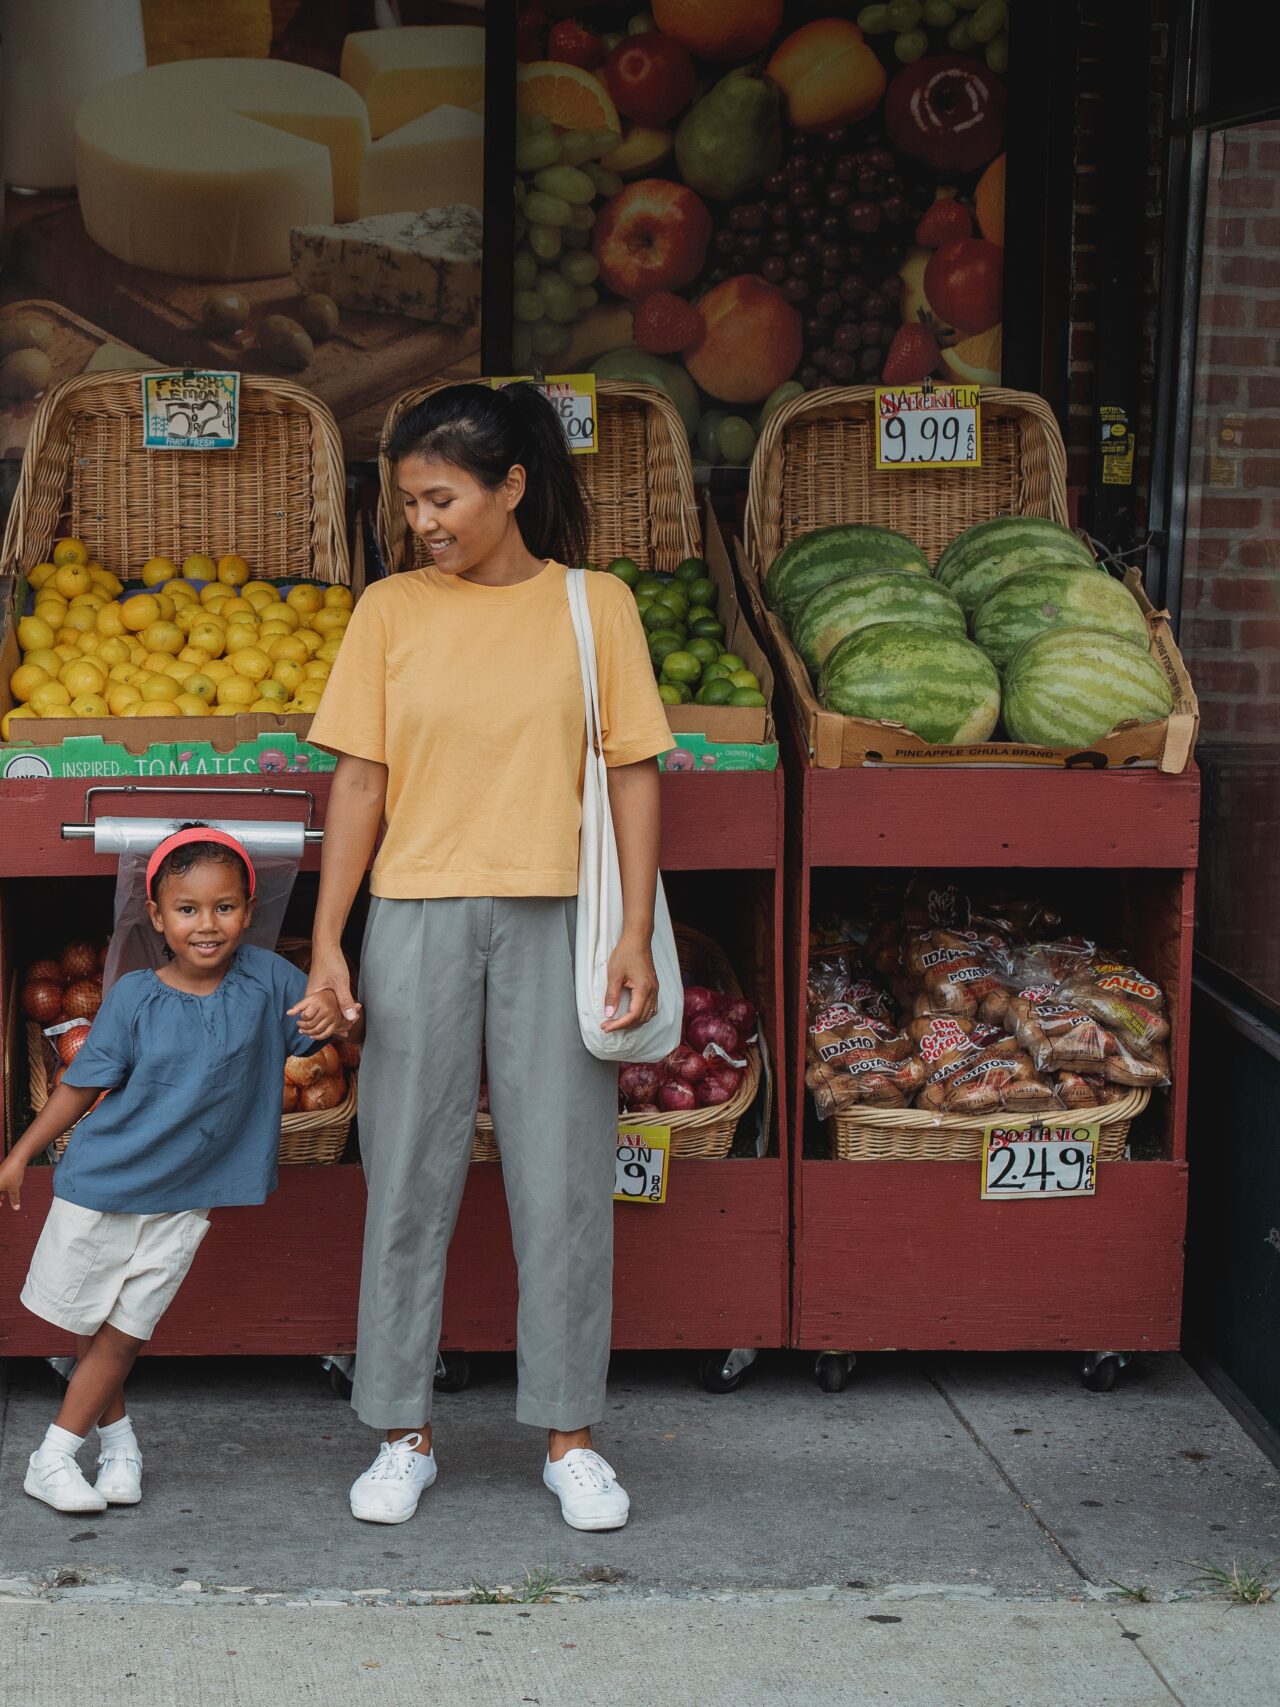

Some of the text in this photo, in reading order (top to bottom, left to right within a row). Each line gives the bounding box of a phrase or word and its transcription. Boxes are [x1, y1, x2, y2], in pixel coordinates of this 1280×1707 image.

[156, 376, 219, 389] FRESH
[156, 389, 219, 401] LEMON
[166, 402, 192, 438] 5
[189, 439, 216, 447] FRESH
[885, 416, 960, 462] 9.99
[966, 423, 975, 461] EACH
[895, 749, 965, 758] PINEAPPLE
[969, 748, 1009, 757] CHULA
[62, 760, 120, 778] INSPIRED
[1095, 975, 1159, 1000] AHO
[932, 1019, 957, 1030] the
[821, 1038, 875, 1060] IDAHO
[921, 1028, 963, 1050] Great
[954, 1060, 1017, 1086] POTATOES
[988, 1147, 1085, 1191] 2.49
[1085, 1154, 1095, 1190] BAG
[649, 1174, 662, 1202] BAG
